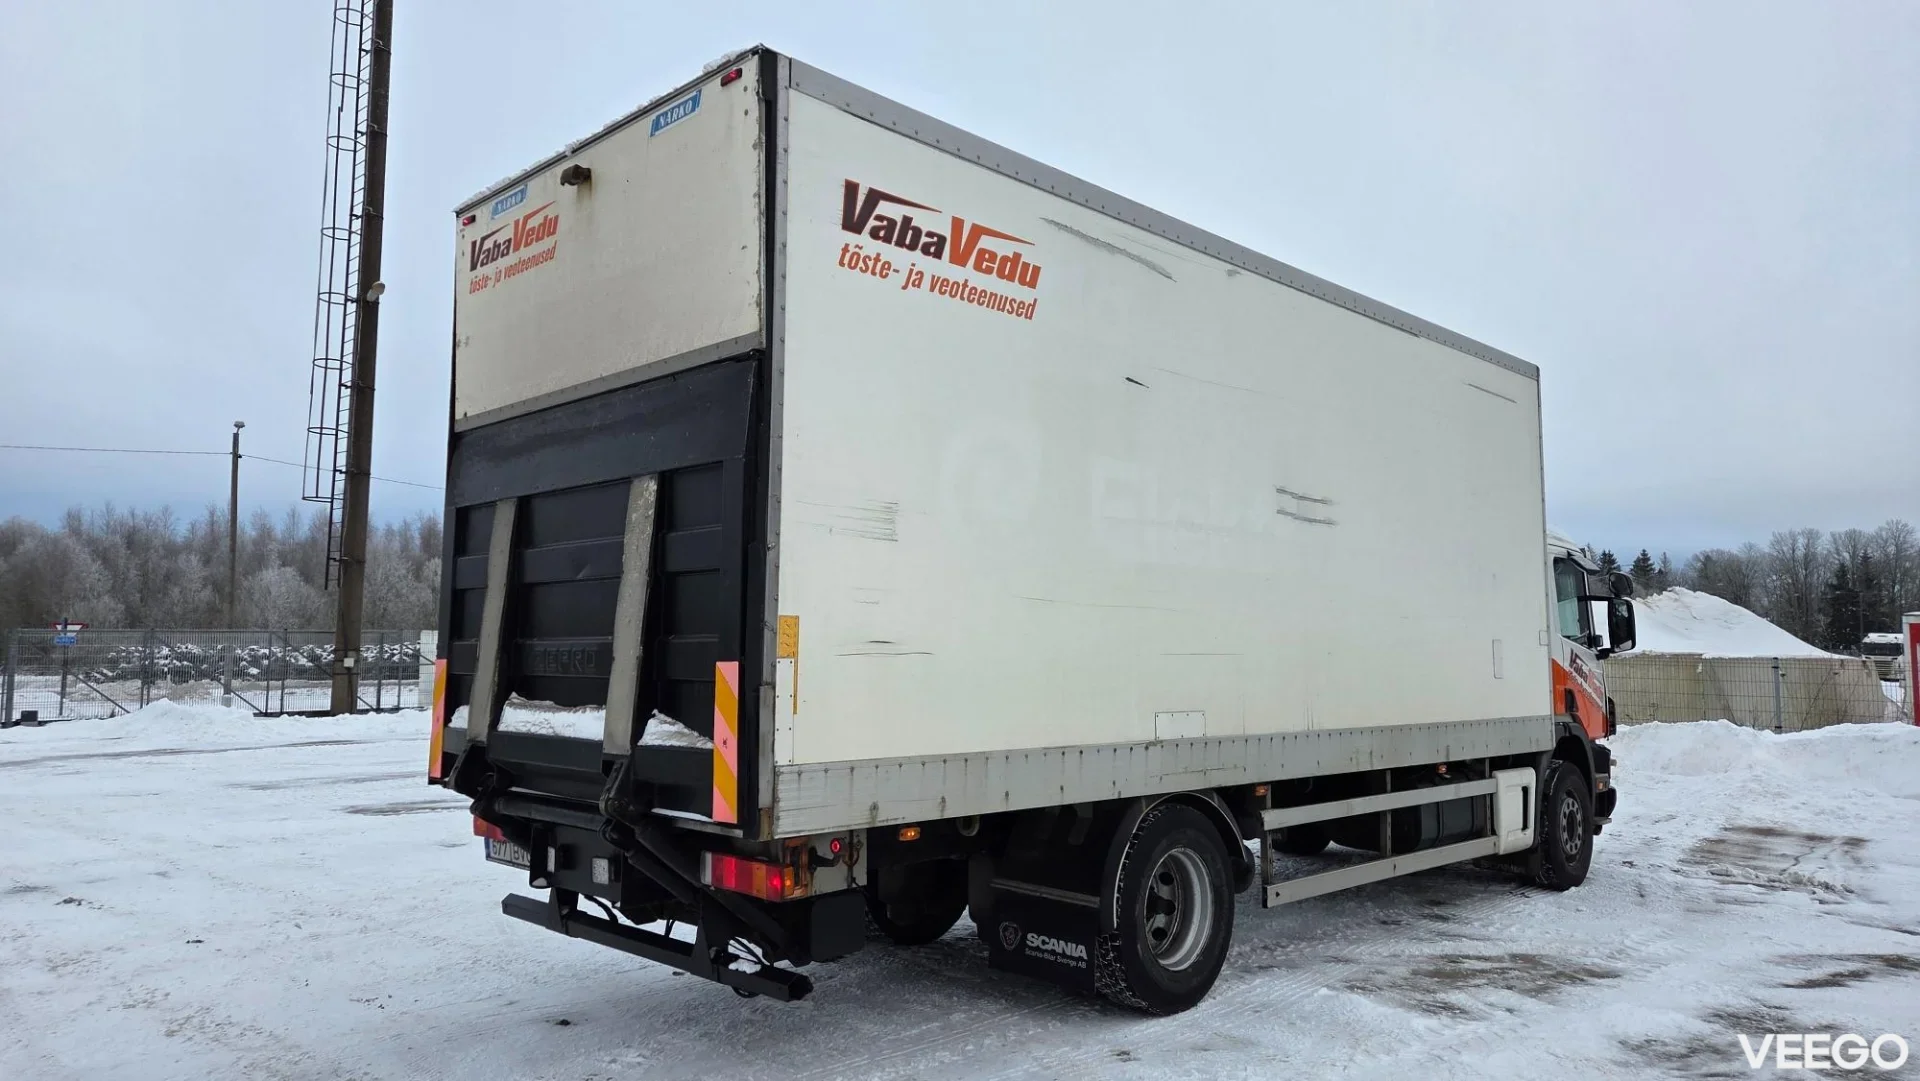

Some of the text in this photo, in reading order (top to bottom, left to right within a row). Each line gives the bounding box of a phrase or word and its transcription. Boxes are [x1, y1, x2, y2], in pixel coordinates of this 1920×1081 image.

[470, 200, 559, 272] VabaVedu
[492, 266, 502, 288] ja
[503, 240, 558, 280] veoteenused
[841, 178, 1042, 290] VabaVedu
[838, 242, 1038, 321] tõste- ja veoteenused
[1026, 932, 1088, 960] SCANIA
[1078, 961, 1087, 969] AB
